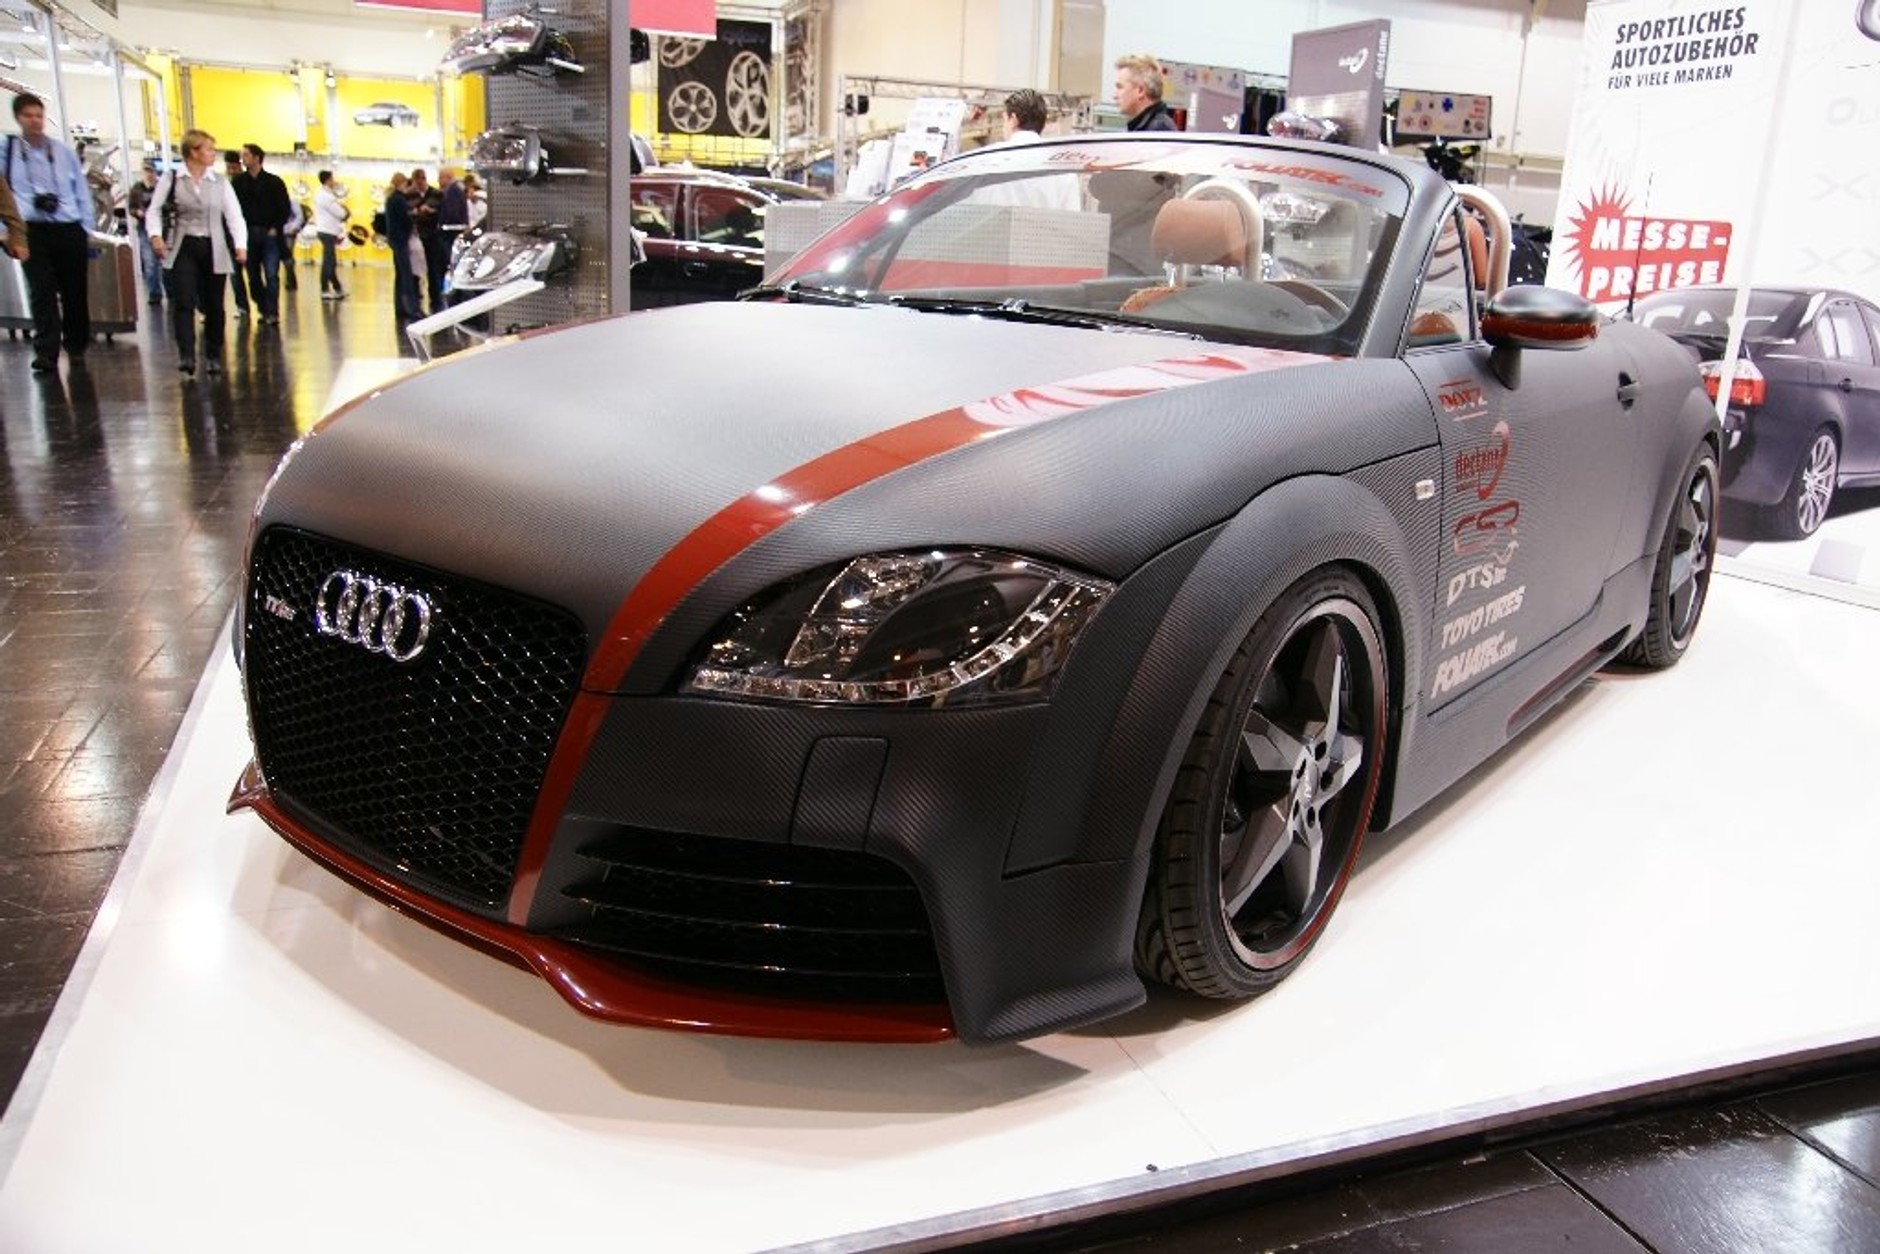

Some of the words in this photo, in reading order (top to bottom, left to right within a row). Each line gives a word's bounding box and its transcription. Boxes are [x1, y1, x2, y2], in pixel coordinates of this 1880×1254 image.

[1616, 7, 1746, 44] SPORTLICHES
[1611, 30, 1759, 70] AUTOZUBEHÖR
[1608, 73, 1632, 90] FÜR
[1637, 71, 1669, 88] VIELE
[1674, 64, 1733, 84] MARKEN
[1590, 217, 1728, 250] MESSE-
[1586, 261, 1720, 299] PREISE
[1441, 606, 1485, 650] TOYO
